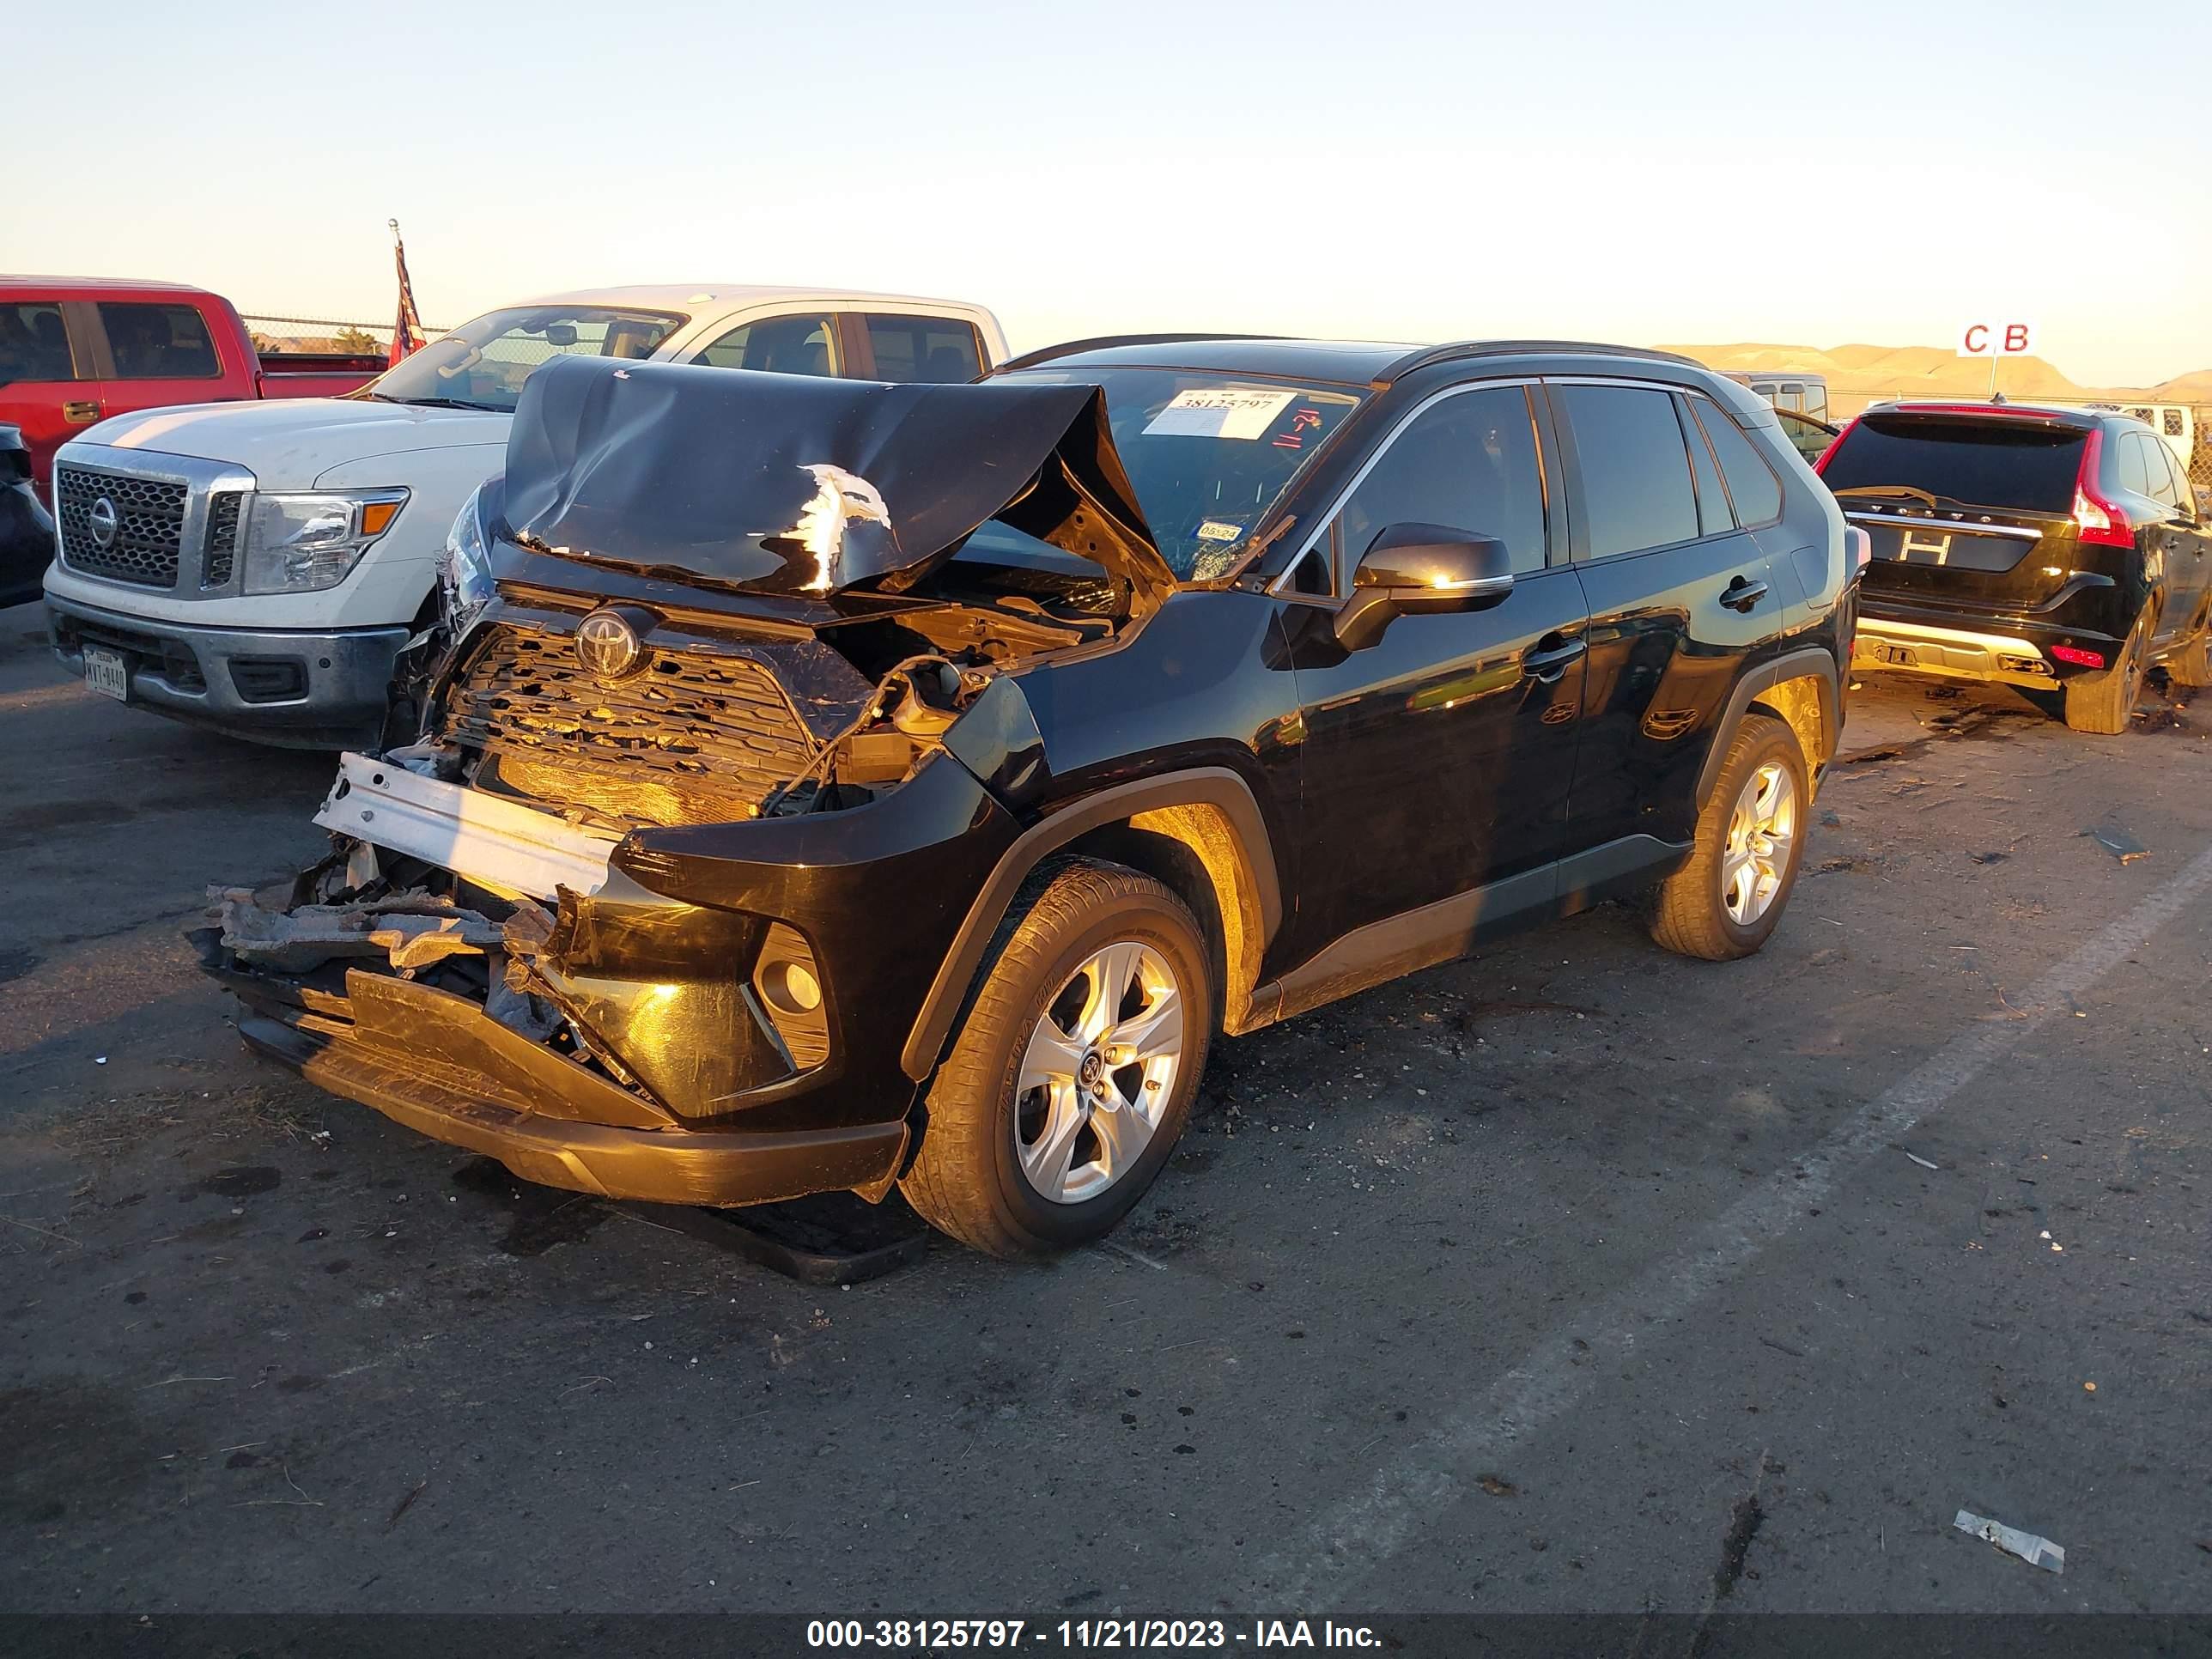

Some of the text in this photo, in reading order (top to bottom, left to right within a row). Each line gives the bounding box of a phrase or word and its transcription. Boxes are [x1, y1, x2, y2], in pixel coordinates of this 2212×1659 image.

[1965, 325, 2028, 353] C B
[1179, 399, 1272, 410] 38125797
[1899, 531, 1952, 565] H
